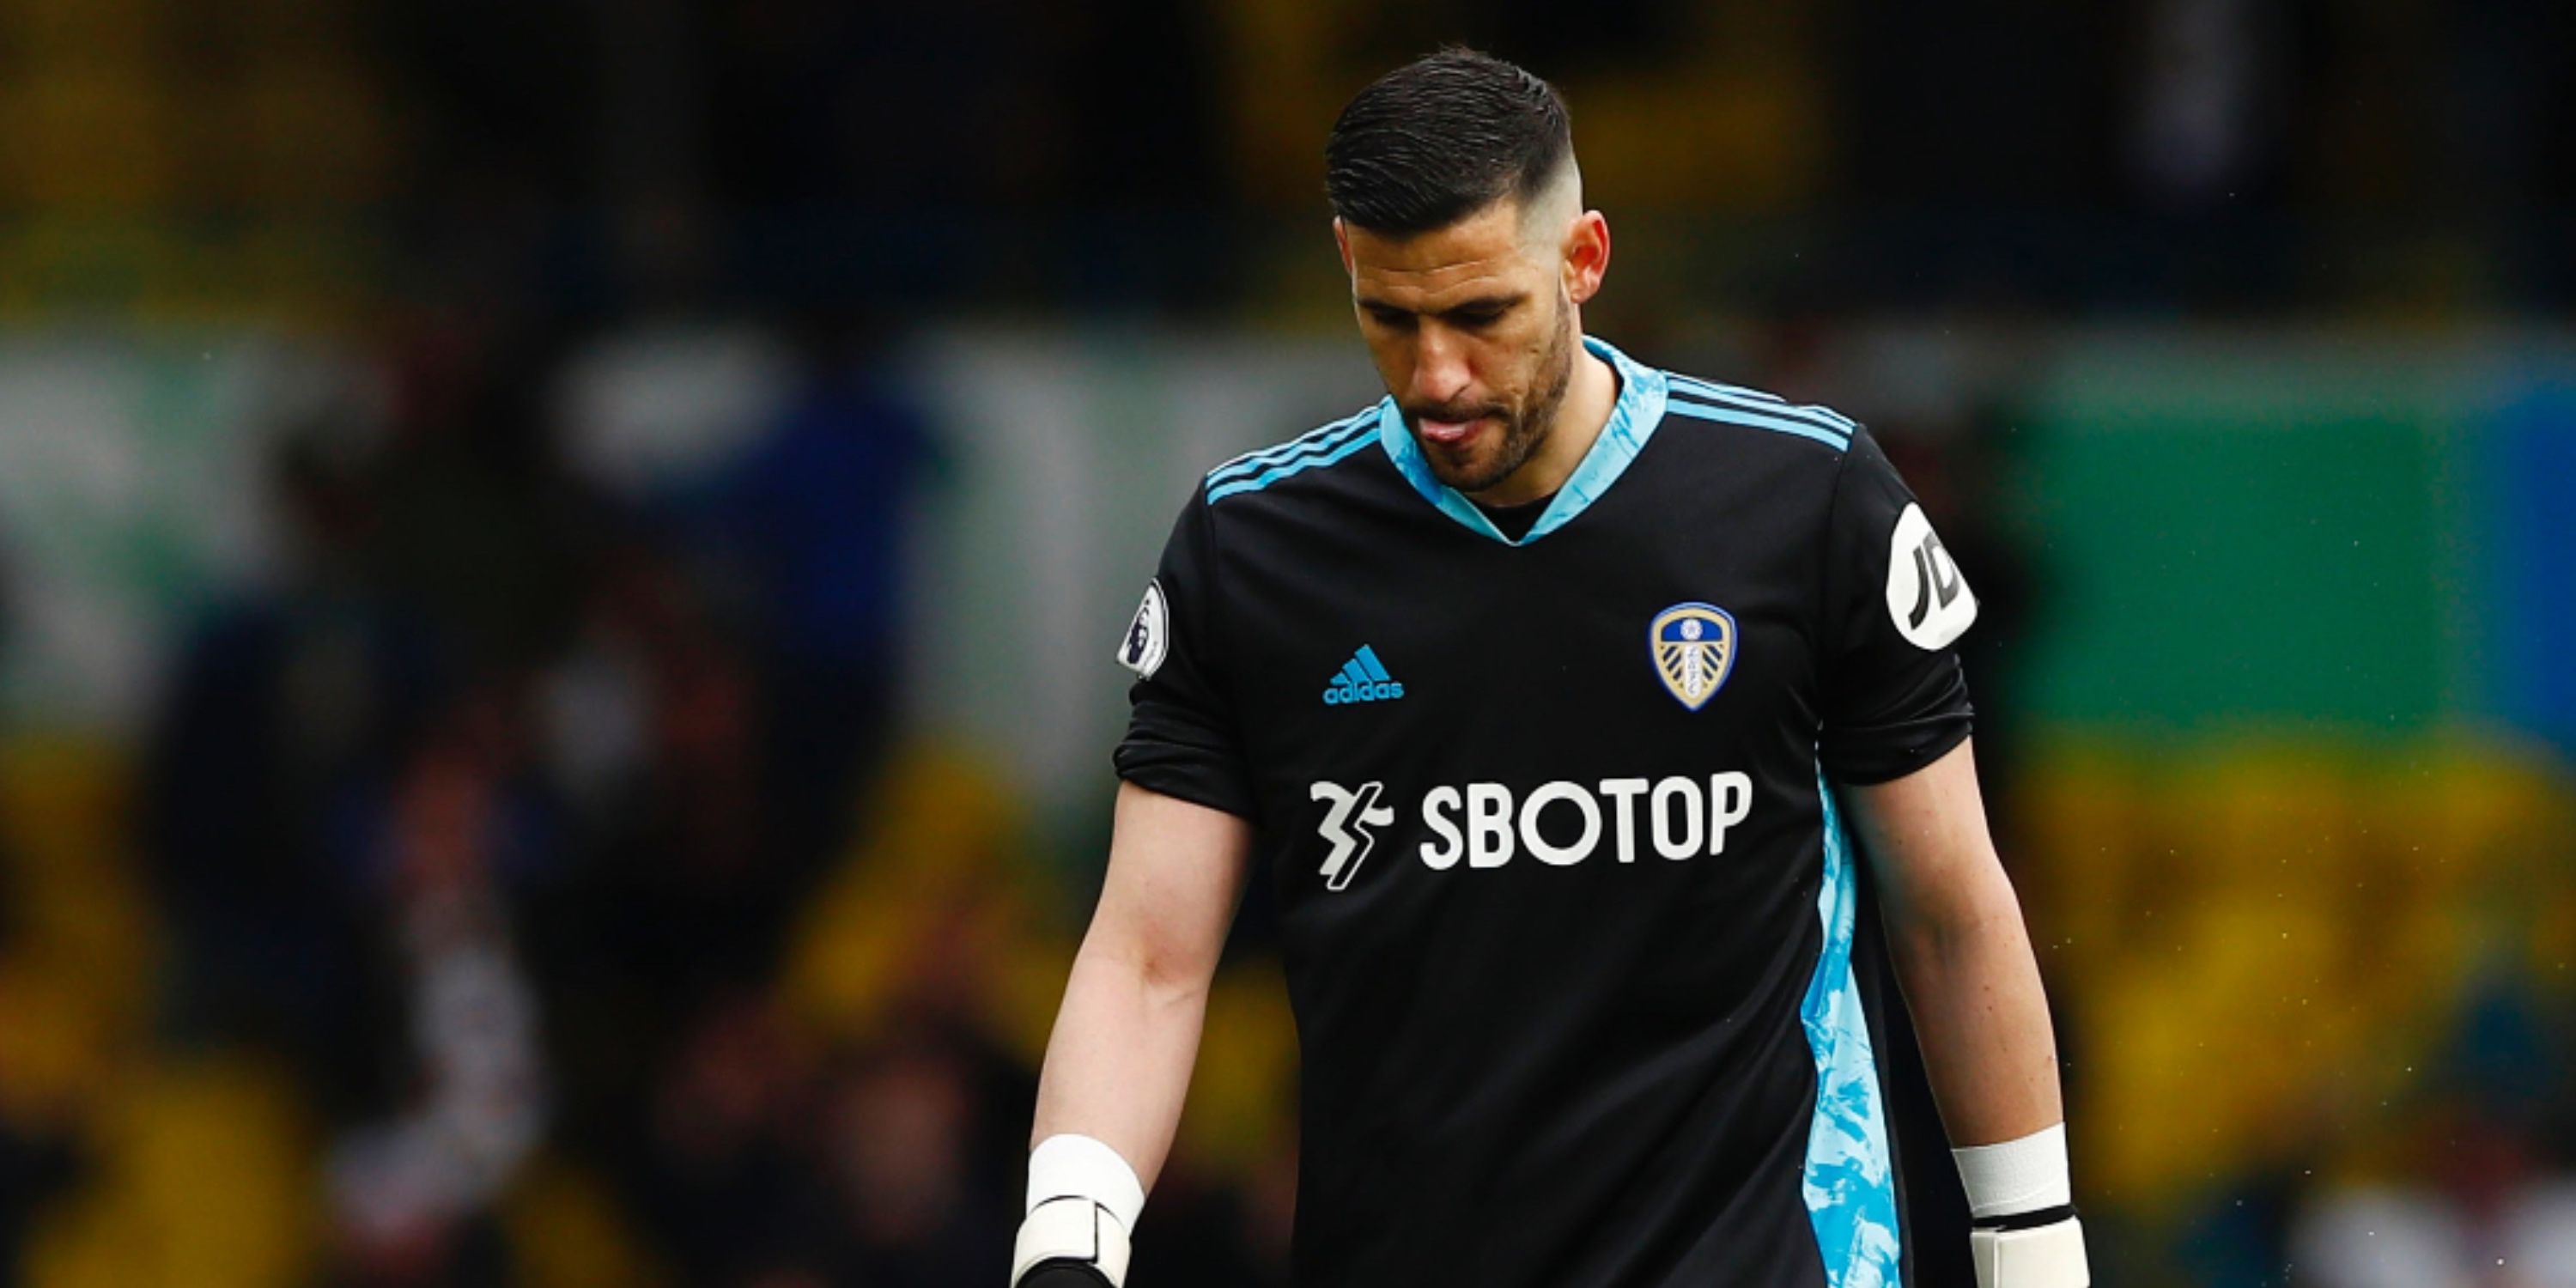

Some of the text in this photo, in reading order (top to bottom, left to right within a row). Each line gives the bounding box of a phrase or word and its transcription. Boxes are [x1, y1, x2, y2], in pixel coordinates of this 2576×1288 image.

[1908, 531, 1960, 630] JD
[1322, 681, 1404, 704] adidas
[1419, 771, 1753, 870] SBOTOP
